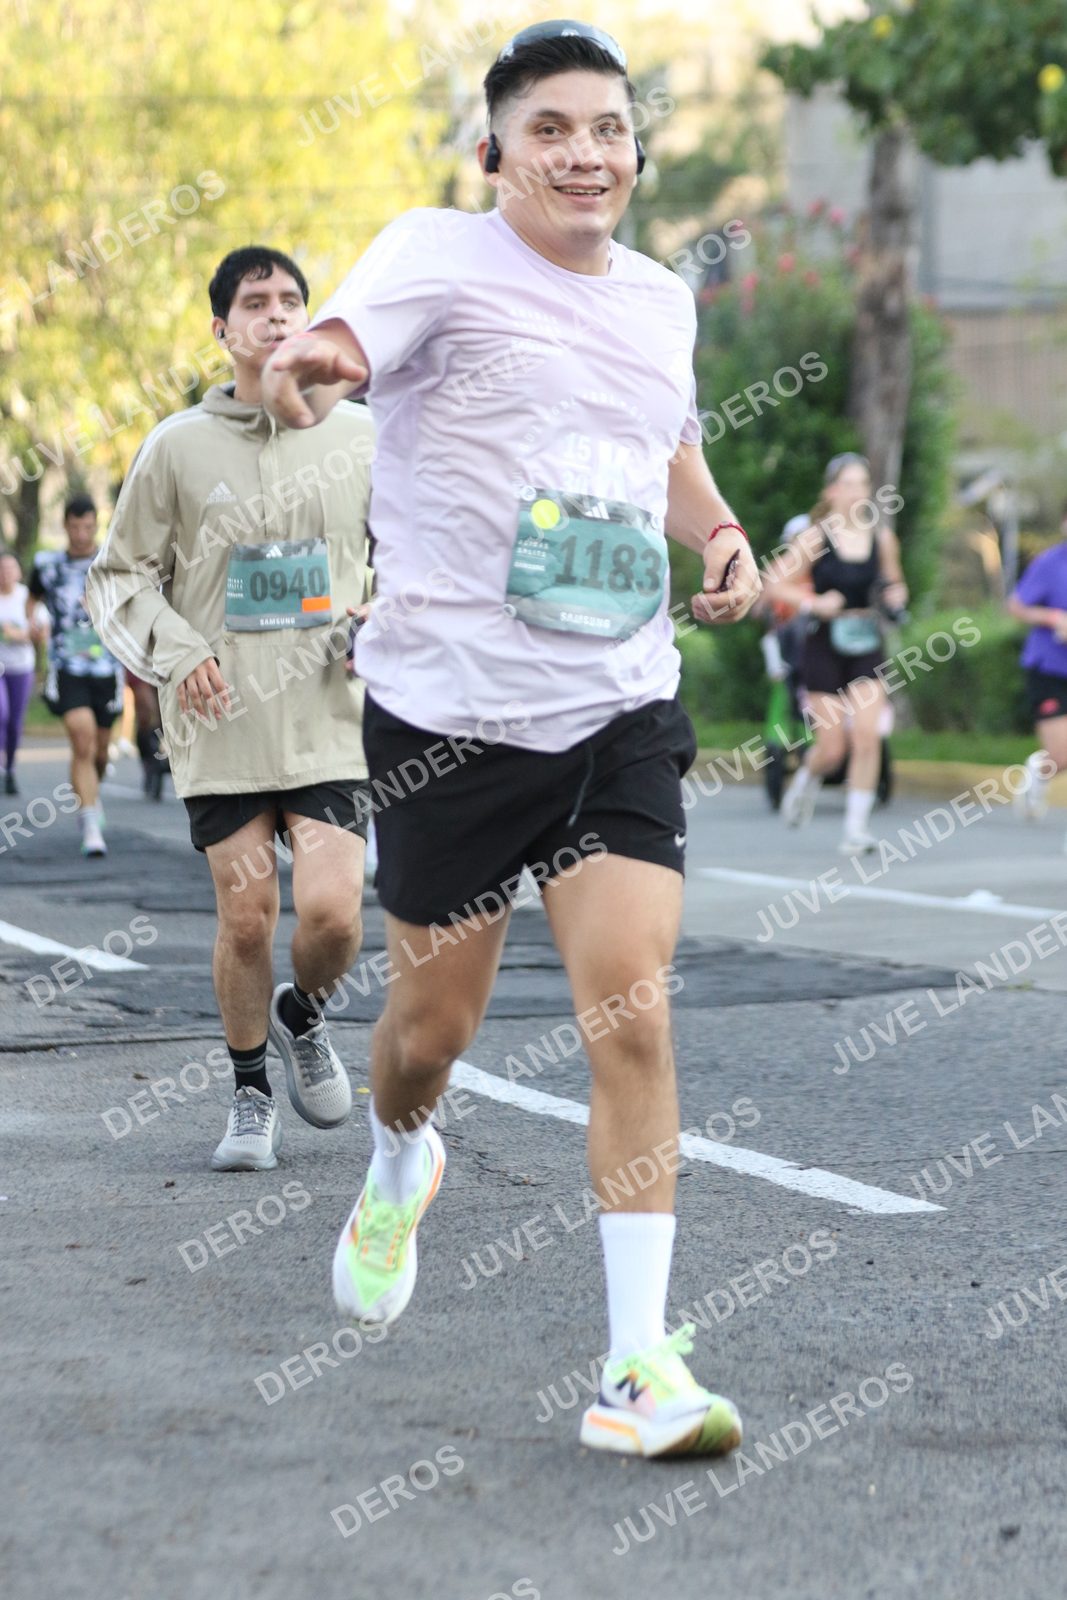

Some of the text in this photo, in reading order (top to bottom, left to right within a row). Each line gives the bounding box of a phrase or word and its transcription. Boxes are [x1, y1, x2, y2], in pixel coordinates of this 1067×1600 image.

[554, 534, 663, 597] 1183
[251, 566, 325, 602] 0940
[260, 616, 295, 626] SAMSUNG
[560, 611, 611, 628] SAMSUNG
